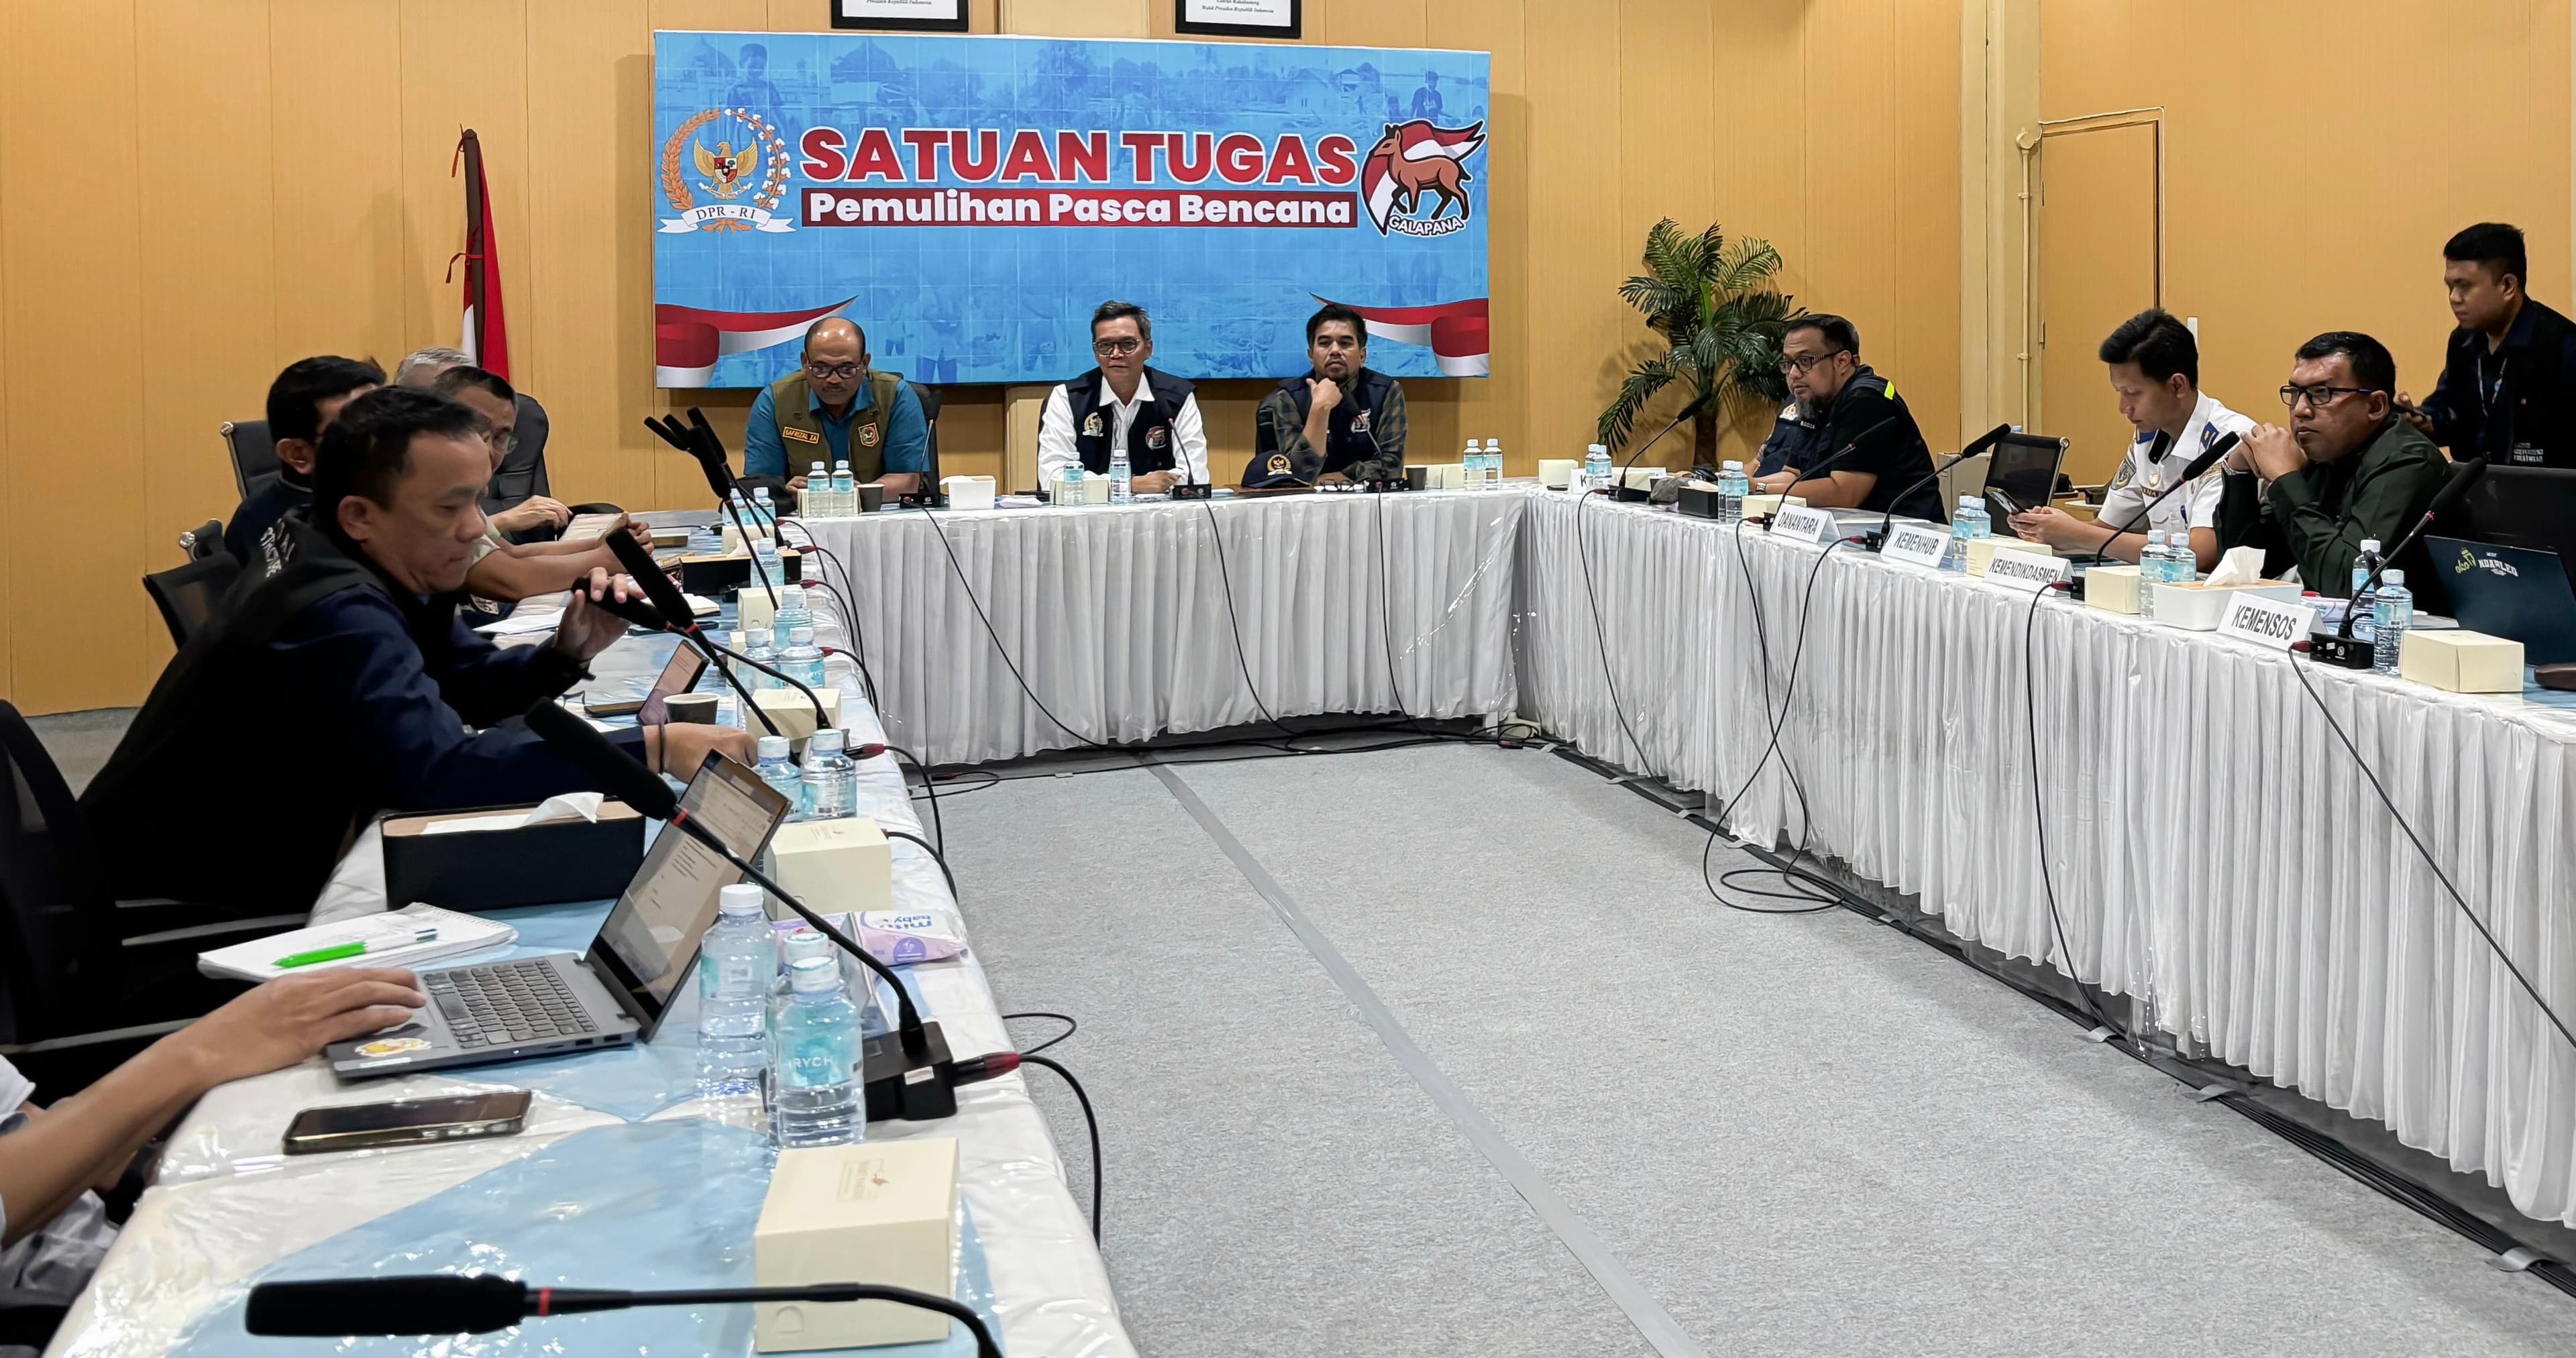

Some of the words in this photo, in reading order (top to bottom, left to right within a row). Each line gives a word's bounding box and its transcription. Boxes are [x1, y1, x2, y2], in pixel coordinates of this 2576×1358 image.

[800, 126, 1110, 183] SATUAN
[1120, 130, 1358, 185] TUGAS
[696, 207, 725, 220] DPR
[739, 207, 756, 219] RI
[810, 188, 1040, 223] Pemulihan
[1049, 193, 1171, 223] Pasca
[1179, 194, 1350, 223] Bencana
[1388, 215, 1463, 235] GALAPANA
[1778, 512, 1819, 535] DANANTARA
[1894, 531, 1939, 555] KEMENHUB
[1988, 558, 2061, 583] KEMENDIKDASMEN
[2231, 605, 2297, 640] KEMENSOS
